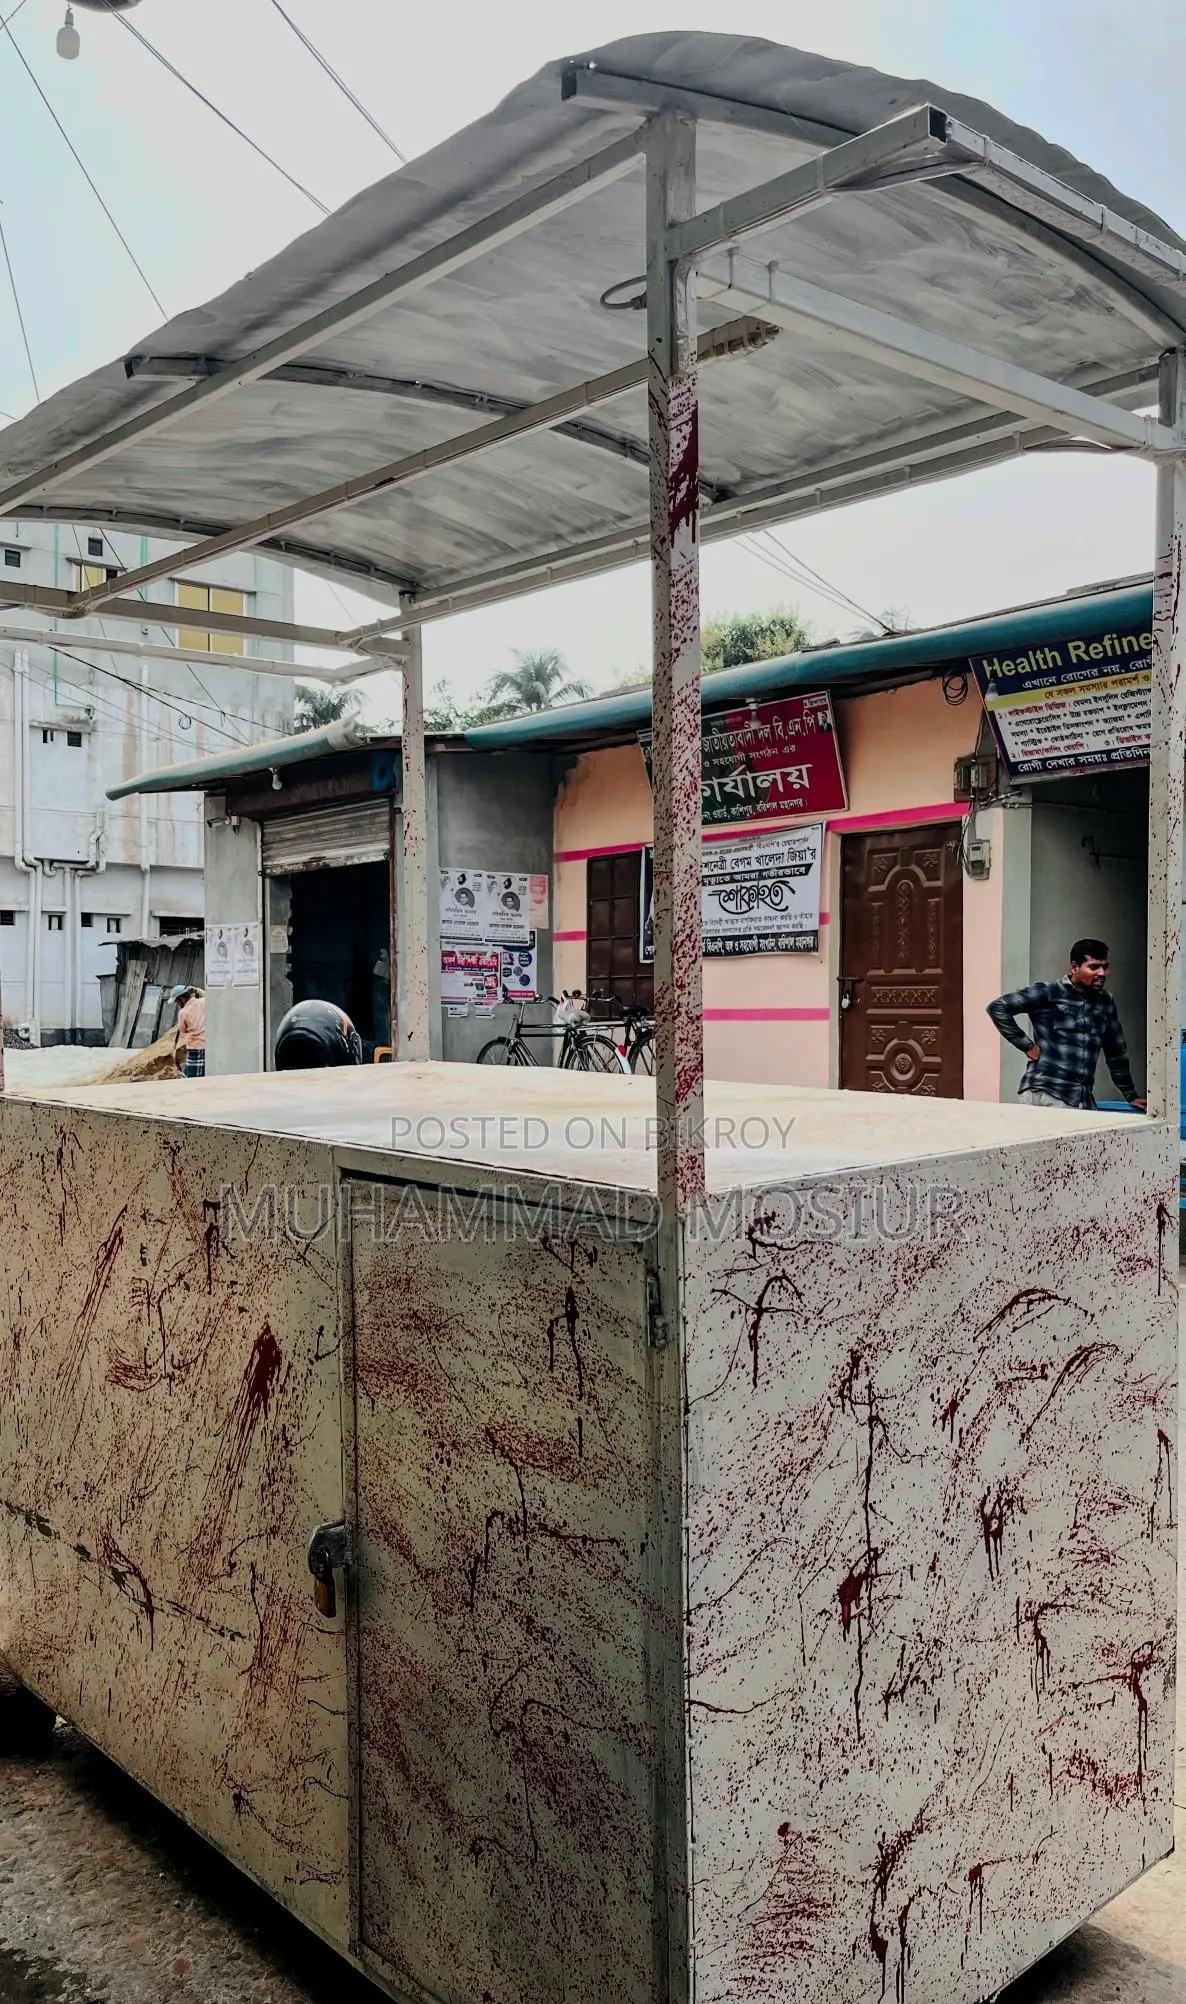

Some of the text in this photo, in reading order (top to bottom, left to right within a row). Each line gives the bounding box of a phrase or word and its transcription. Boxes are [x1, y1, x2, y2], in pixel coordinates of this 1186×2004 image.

[982, 648, 1062, 679] Health
[1022, 676, 1057, 689] এখানে
[1061, 667, 1099, 683] রোগের
[1044, 689, 1054, 699] যে
[1055, 687, 1076, 697] সকল
[1077, 681, 1109, 695] সমস্যার
[1110, 673, 1139, 688] পরামর্শ
[700, 720, 756, 754] জাতীয়তাবাদী
[757, 724, 773, 744] দল
[712, 751, 746, 766] সহযোগী
[748, 746, 779, 759] সংগঠন
[1018, 758, 1043, 773] রোগী
[1046, 756, 1075, 770] দেখার
[701, 855, 727, 872] শনেত্রী
[731, 856, 752, 870] বেগম
[755, 852, 785, 867] খালেদা
[733, 871, 759, 881] আমরা
[761, 865, 807, 879] গভীরভাবে
